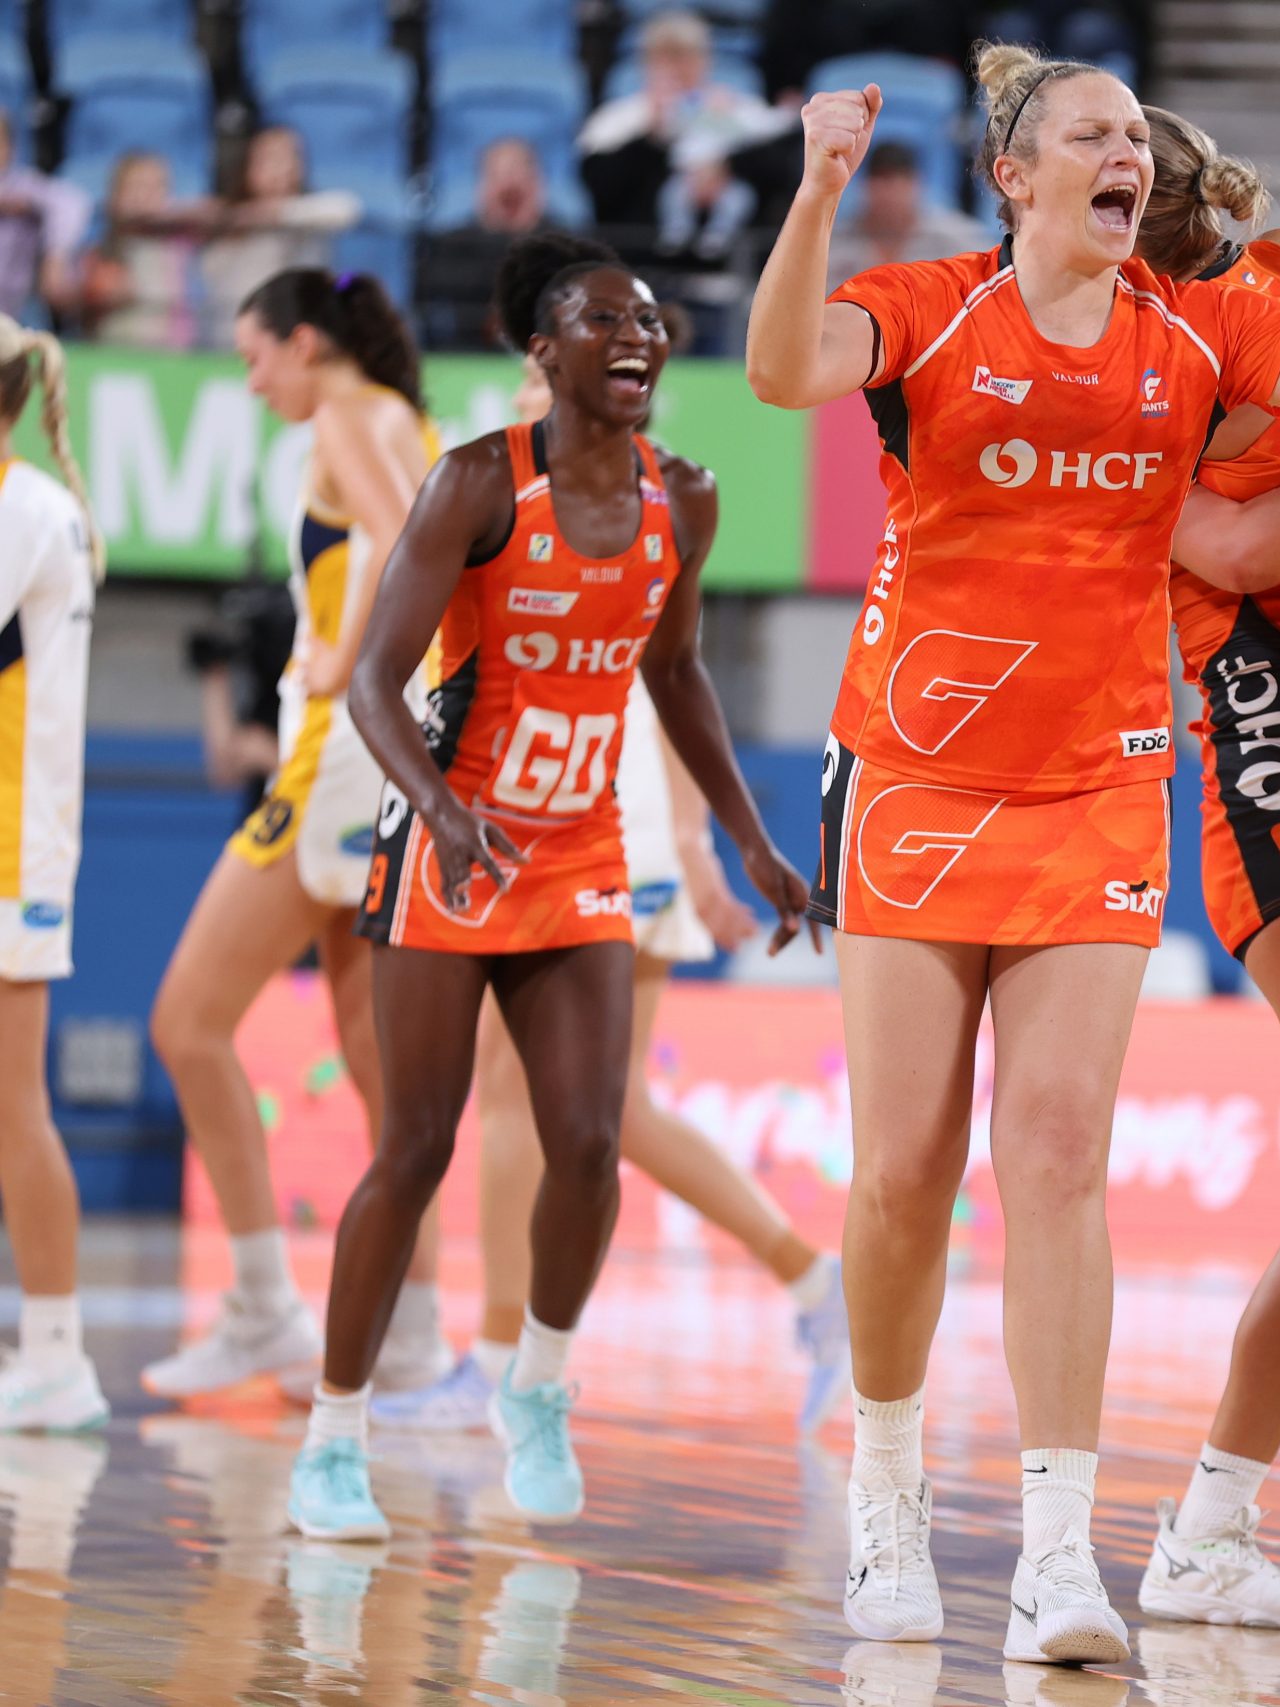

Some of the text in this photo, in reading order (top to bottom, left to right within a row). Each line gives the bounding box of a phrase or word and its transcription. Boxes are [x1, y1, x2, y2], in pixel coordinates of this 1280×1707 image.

[1051, 371, 1099, 385] VALOUR
[1050, 451, 1163, 490] HCF
[872, 518, 899, 600] HCF
[492, 706, 617, 813] GD
[1127, 733, 1167, 753] FDC
[365, 853, 389, 914] 9
